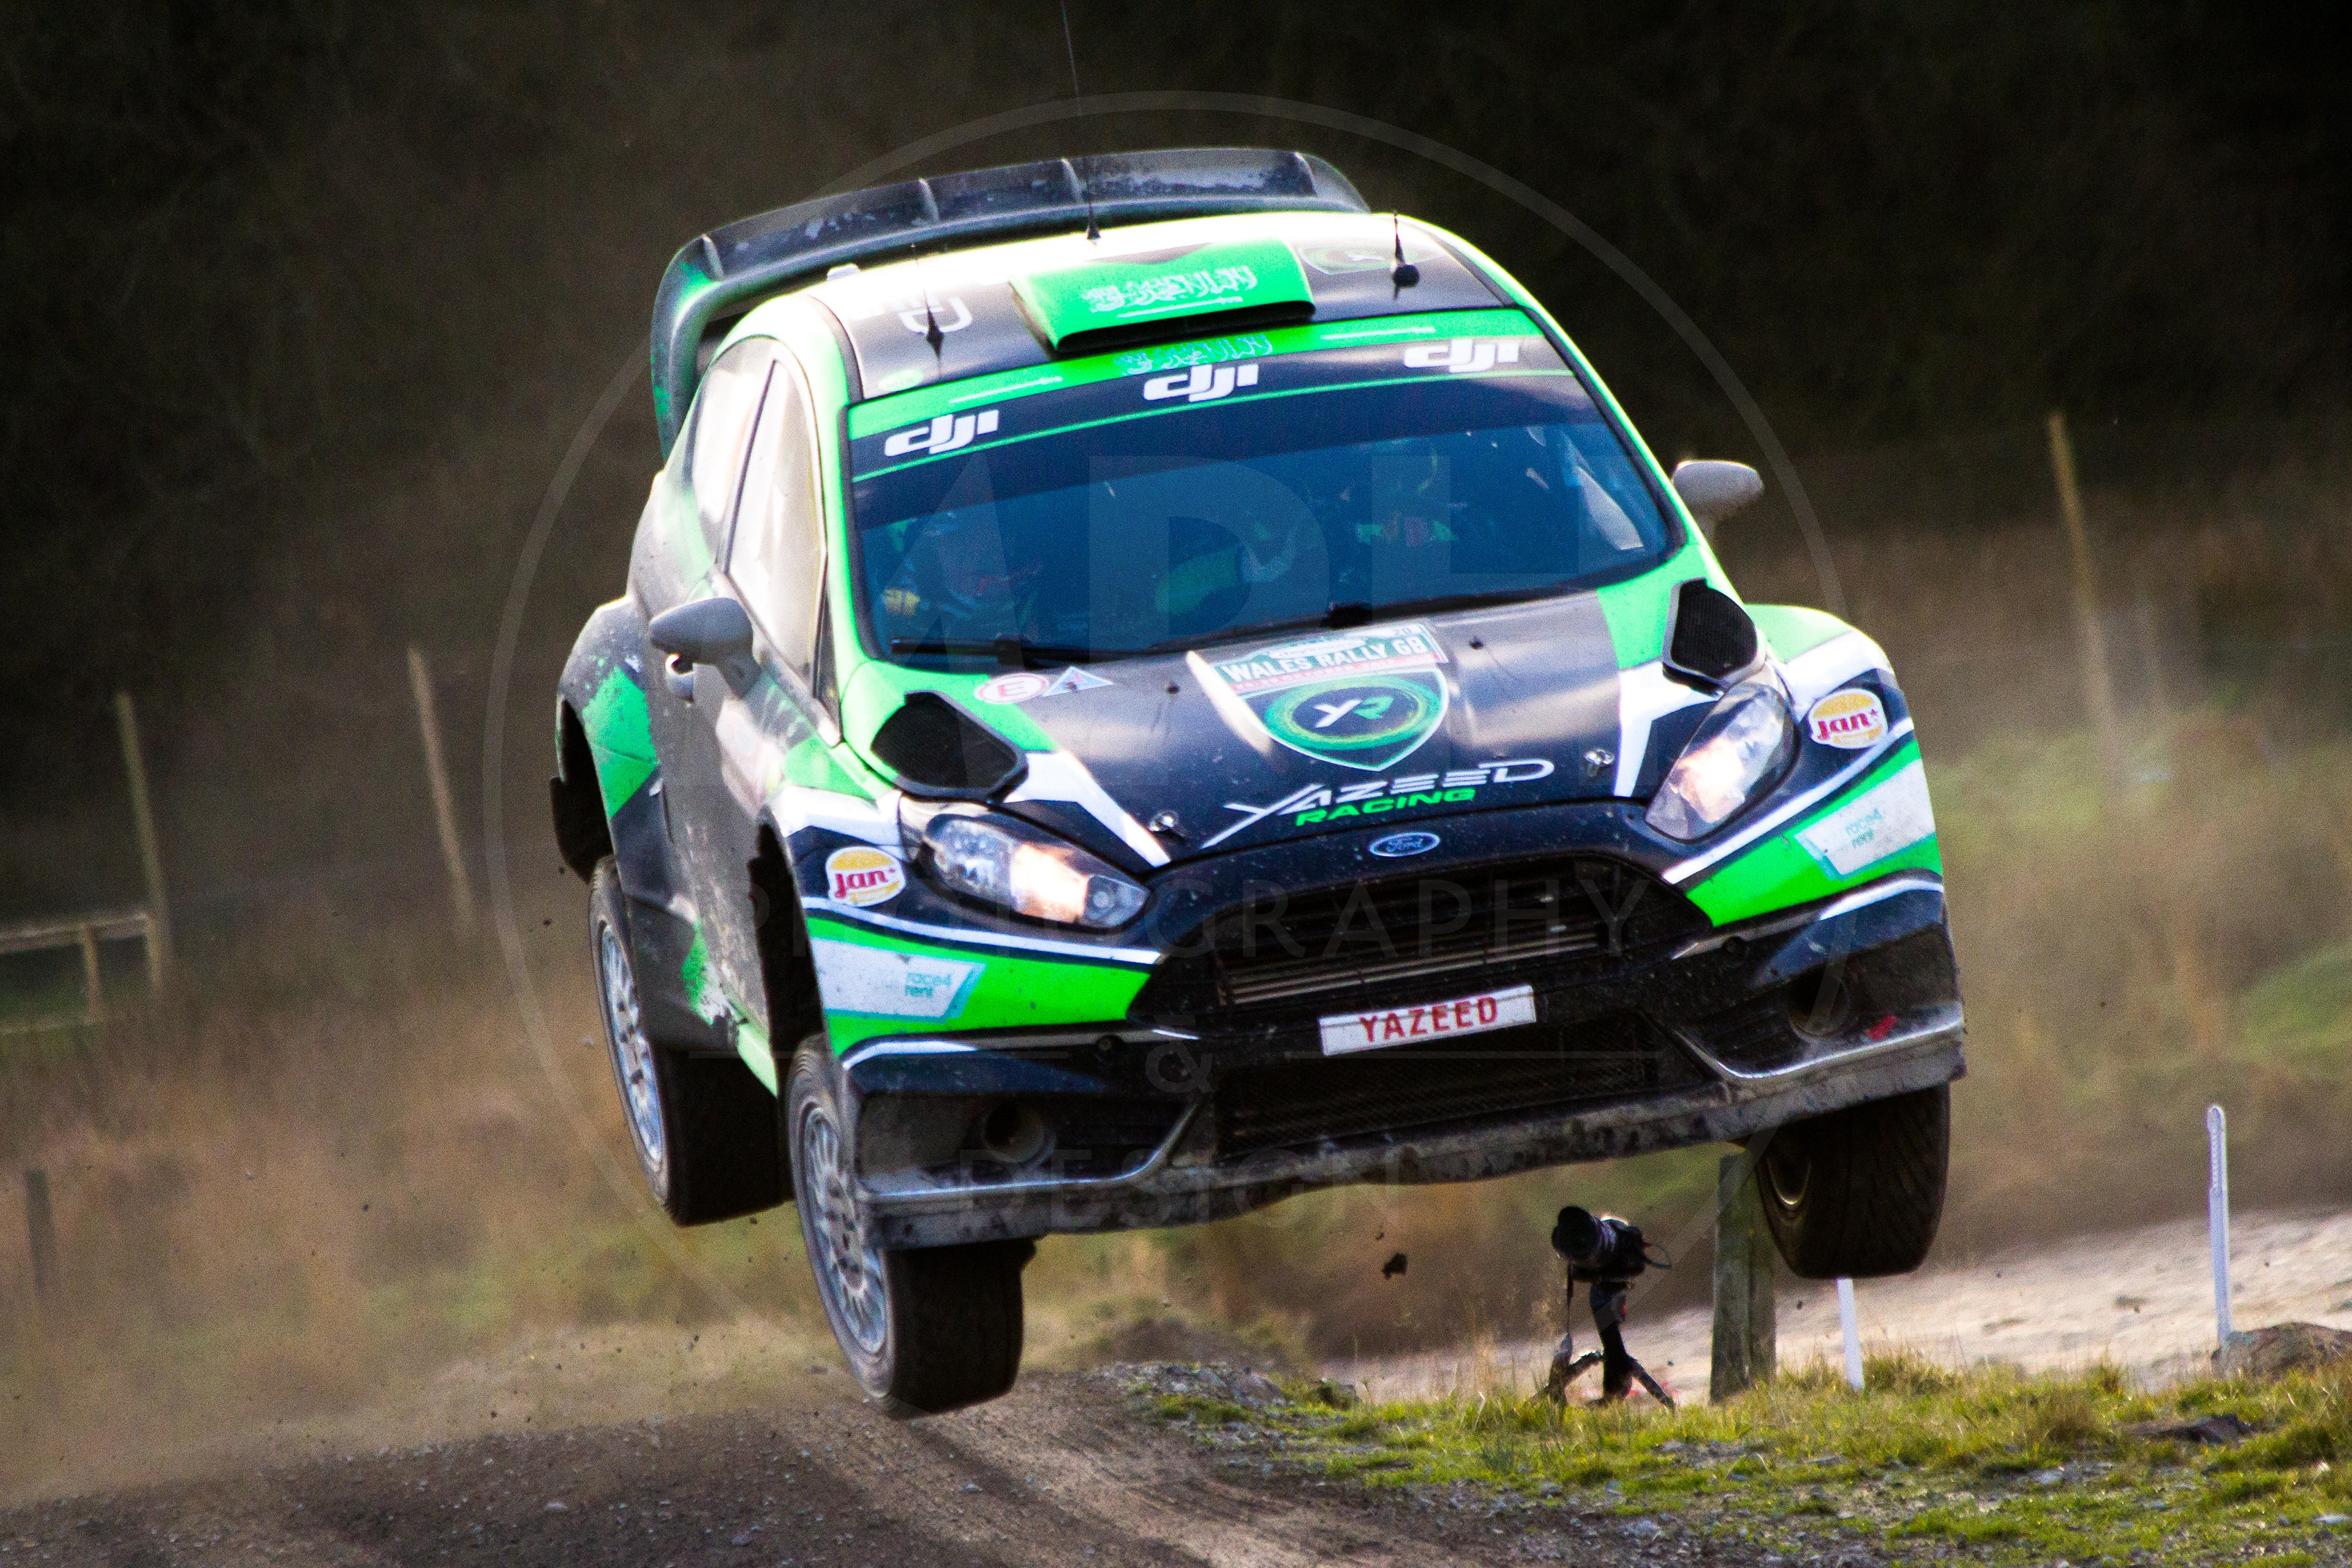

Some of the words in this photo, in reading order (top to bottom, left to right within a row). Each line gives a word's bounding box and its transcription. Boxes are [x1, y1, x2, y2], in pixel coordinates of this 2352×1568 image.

[1221, 655, 1313, 682] WALES
[1314, 643, 1389, 666] RALLY
[1390, 636, 1430, 655] GB
[1199, 759, 1555, 849] YAZEED
[1295, 788, 1476, 826] RACING
[1360, 996, 1498, 1042] YAZEED
